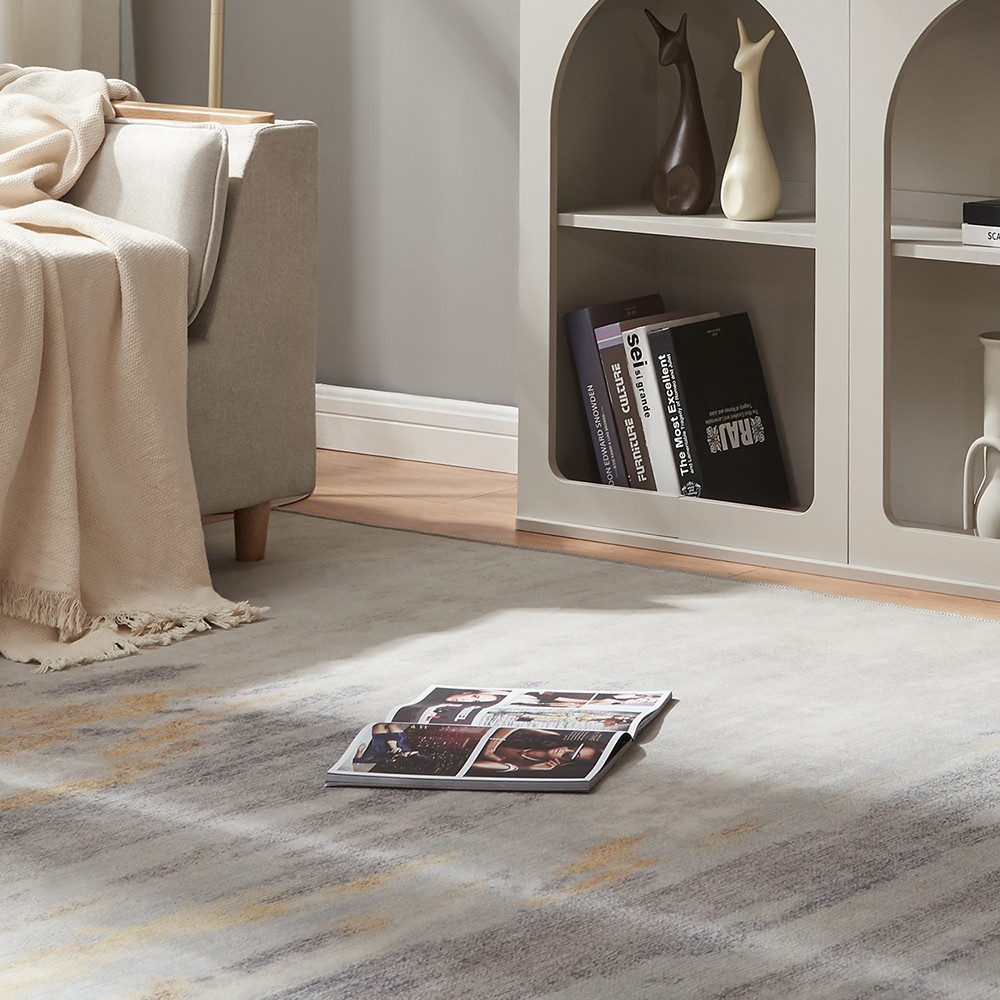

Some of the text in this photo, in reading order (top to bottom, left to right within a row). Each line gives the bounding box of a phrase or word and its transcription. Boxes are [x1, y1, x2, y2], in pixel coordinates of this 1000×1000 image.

[626, 333, 648, 369] sei
[586, 384, 603, 428] SNOWDEN
[635, 381, 651, 418] grande
[657, 353, 689, 476] The Most Excellent
[597, 429, 610, 467] EDWARD
[718, 417, 754, 451] RAJ
